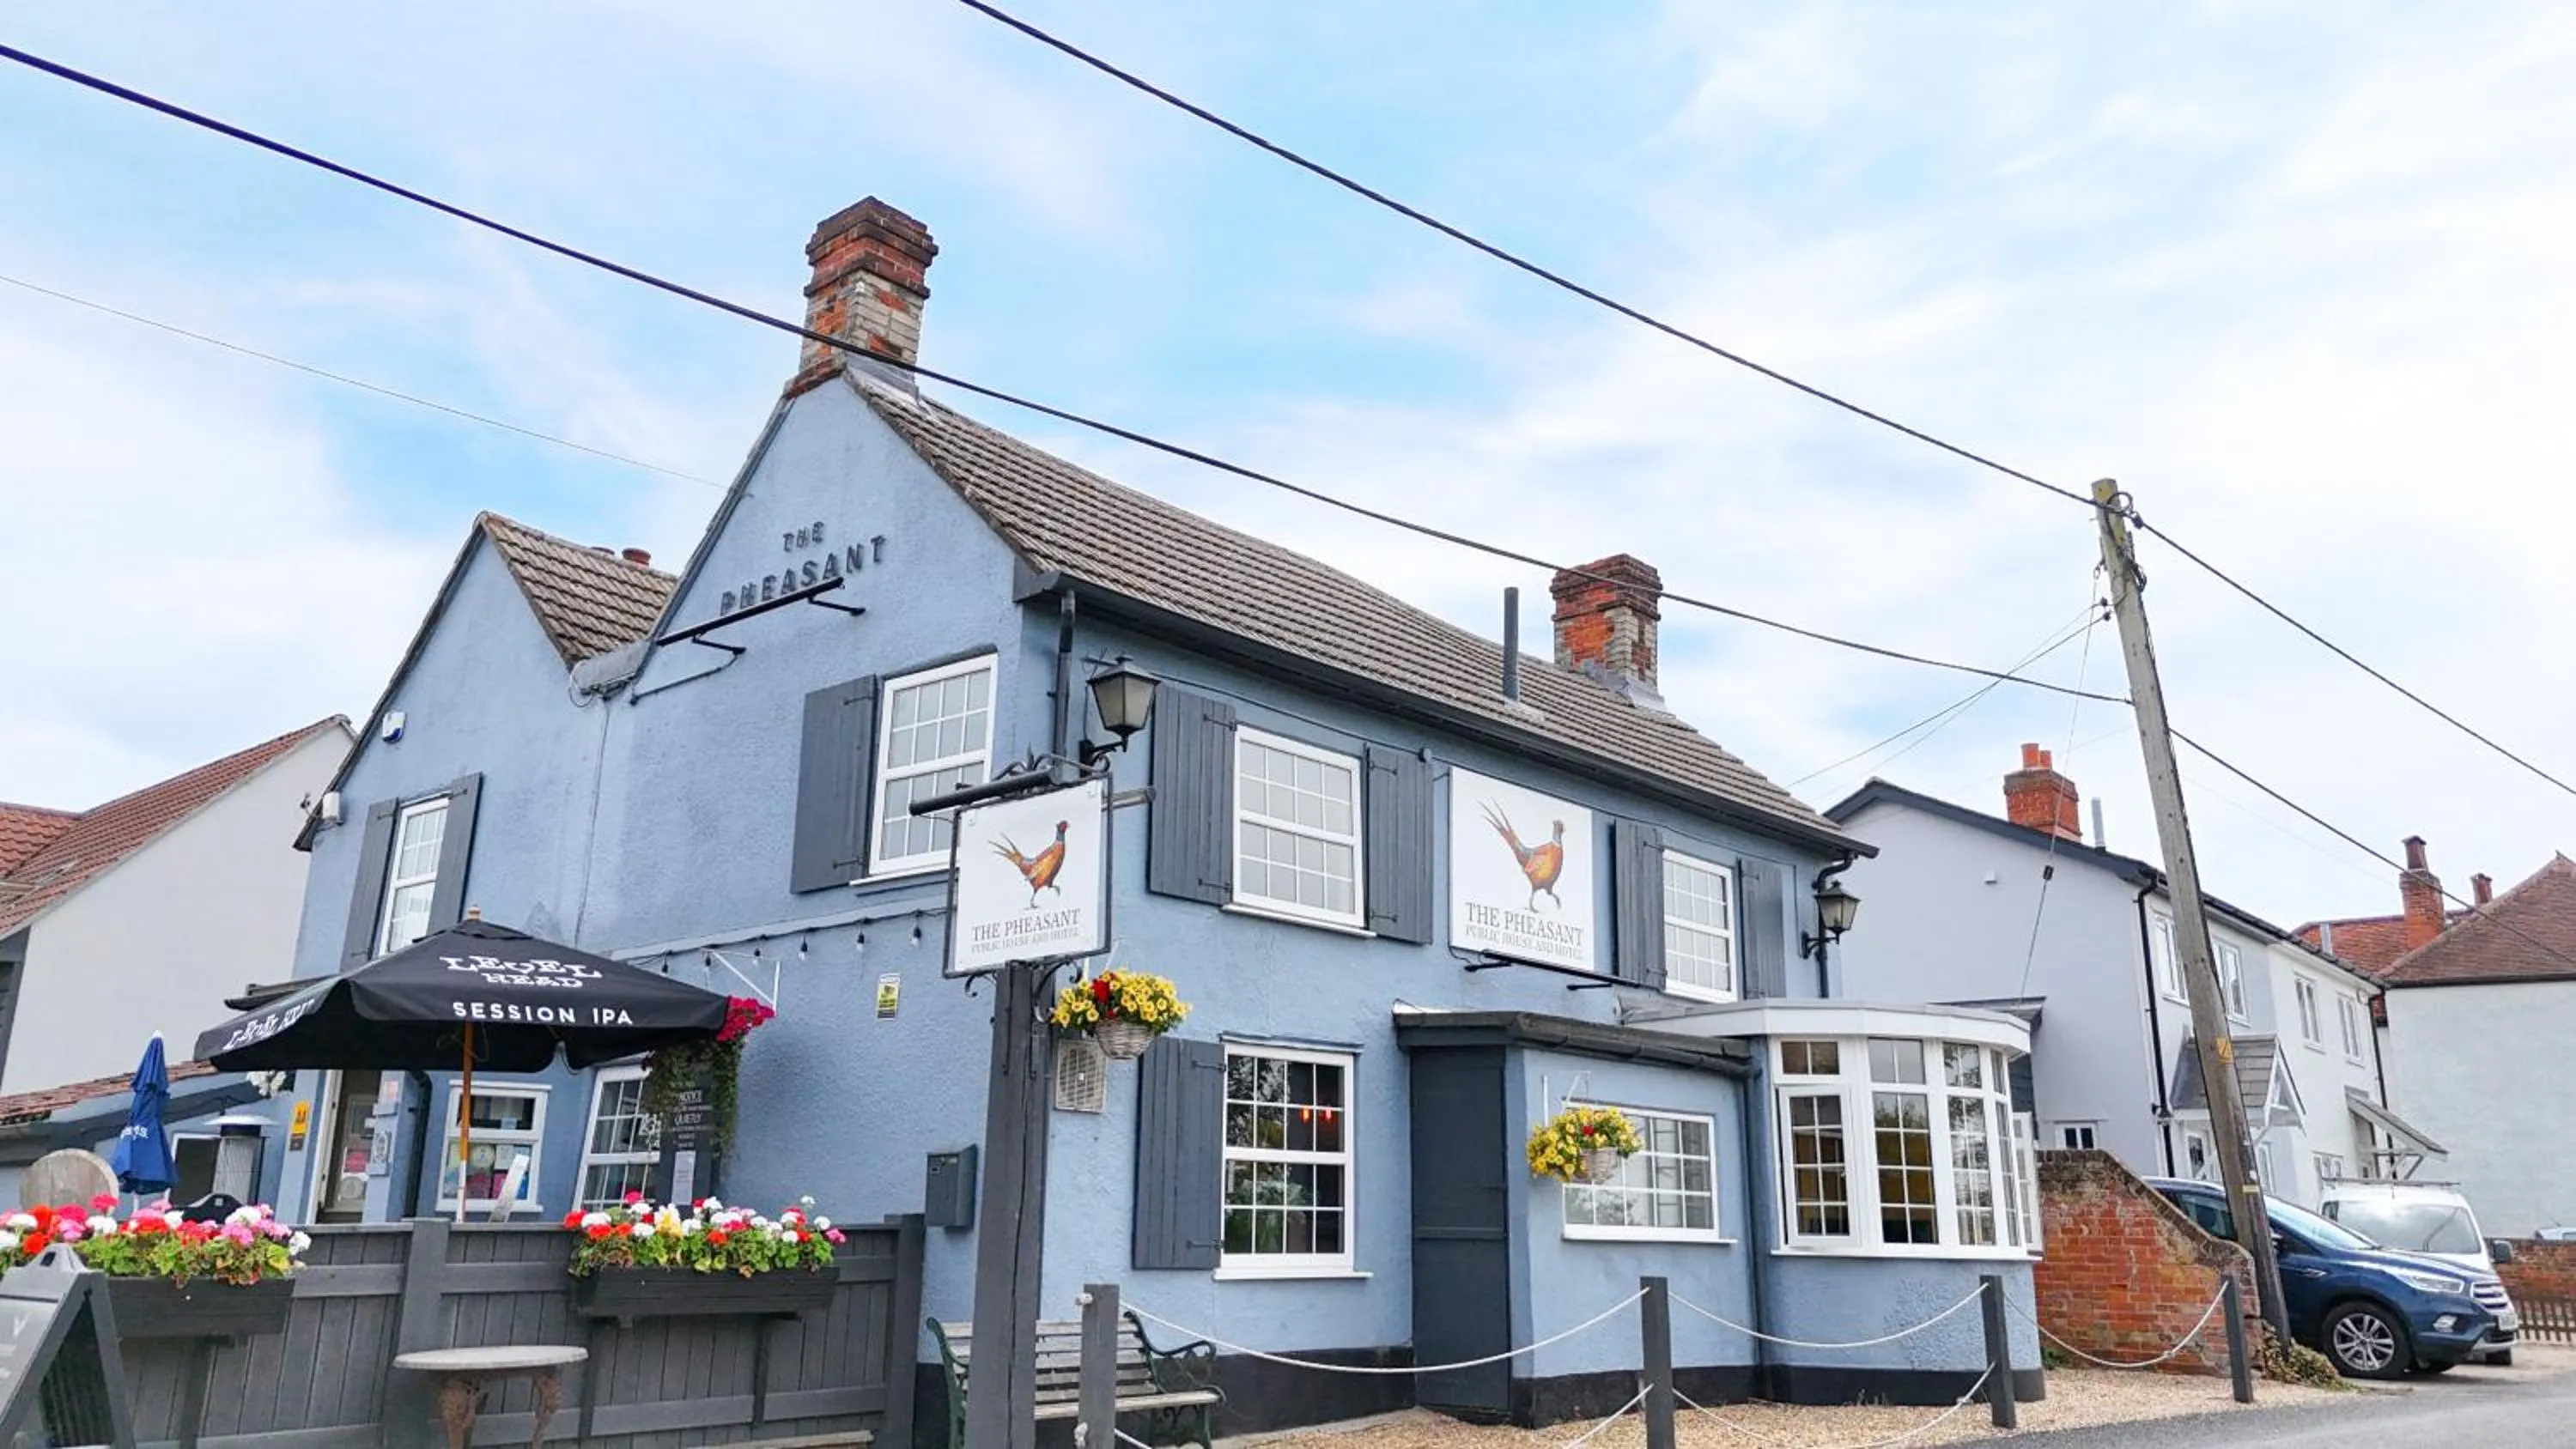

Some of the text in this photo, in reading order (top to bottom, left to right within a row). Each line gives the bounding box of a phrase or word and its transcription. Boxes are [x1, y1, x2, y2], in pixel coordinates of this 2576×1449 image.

[782, 521, 825, 553] THE
[720, 535, 887, 616] PHEASANT
[971, 908, 1081, 942] THE PHEASANT
[1465, 902, 1584, 946] THE PHEASANT
[481, 973, 584, 988] HEAD
[453, 1002, 633, 1026] SESSION IPA
